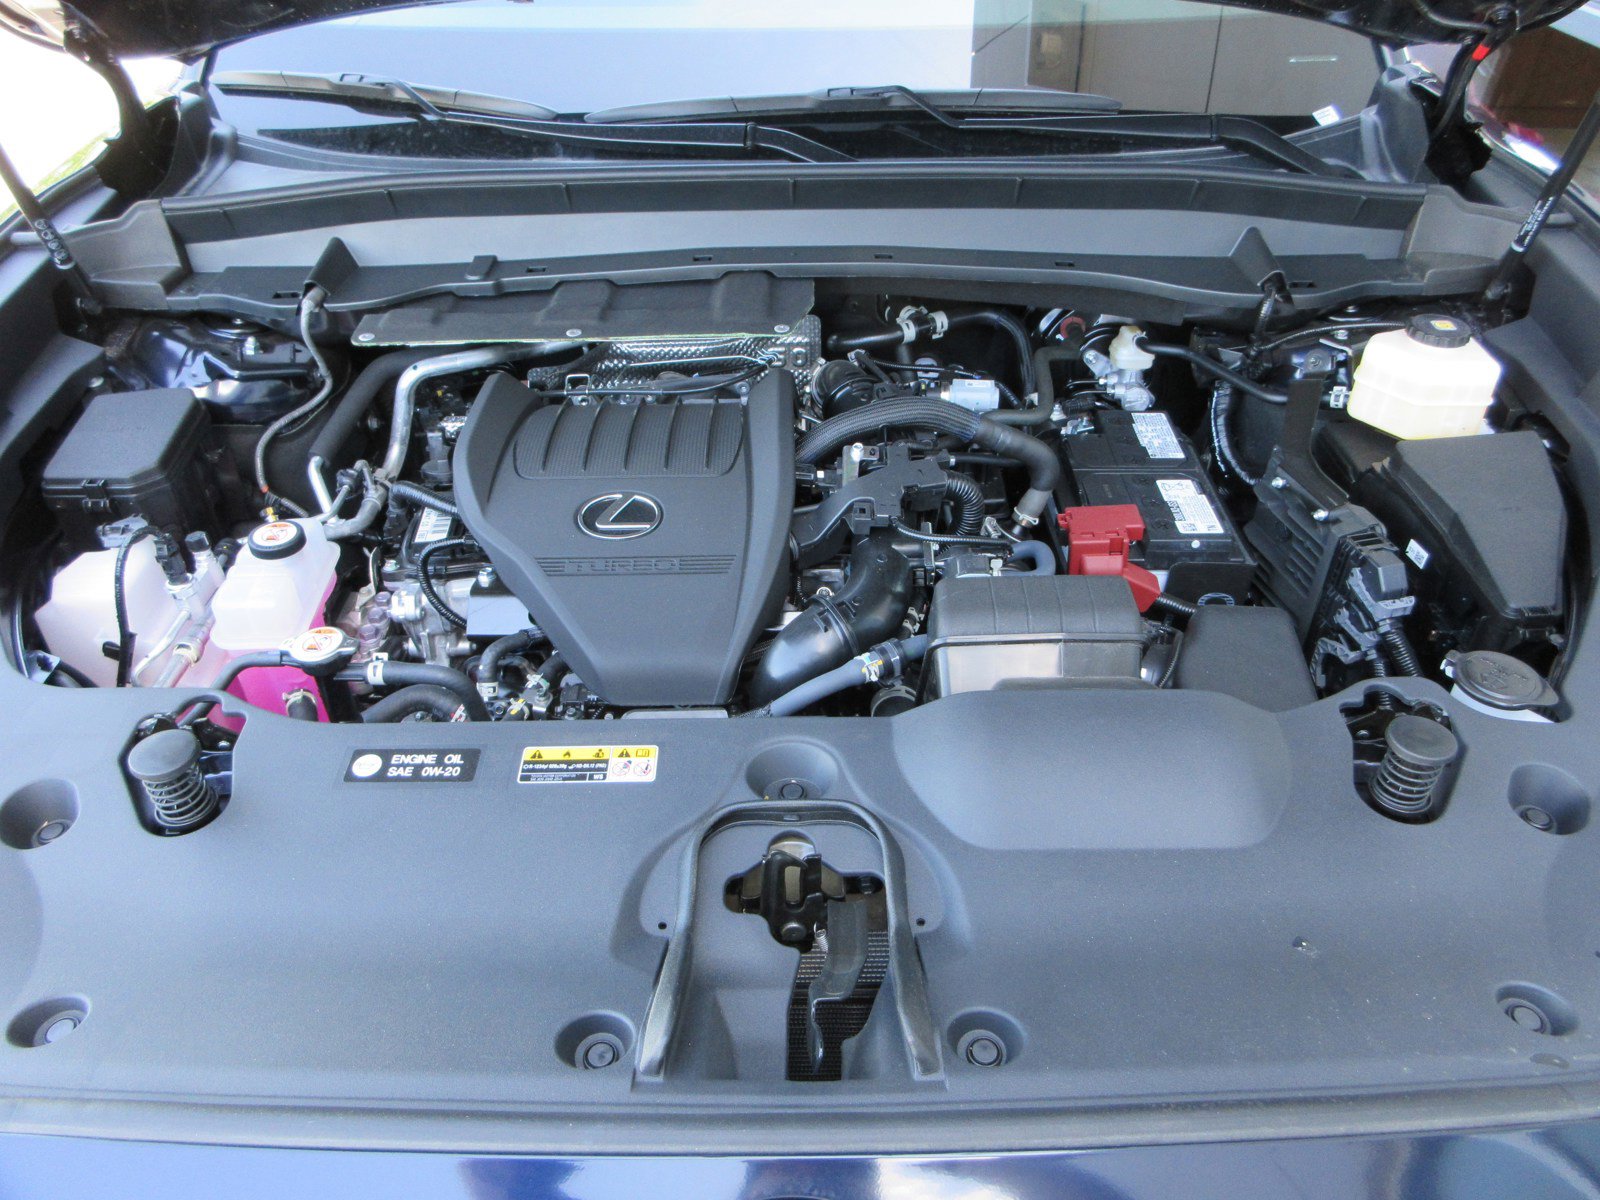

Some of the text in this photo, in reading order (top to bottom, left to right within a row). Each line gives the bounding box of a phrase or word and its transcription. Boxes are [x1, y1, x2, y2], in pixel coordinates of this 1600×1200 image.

[568, 559, 677, 572] TURBO
[390, 754, 464, 765] ENGINE OIL
[387, 766, 414, 777] SAE
[421, 766, 461, 777] 0W-20
